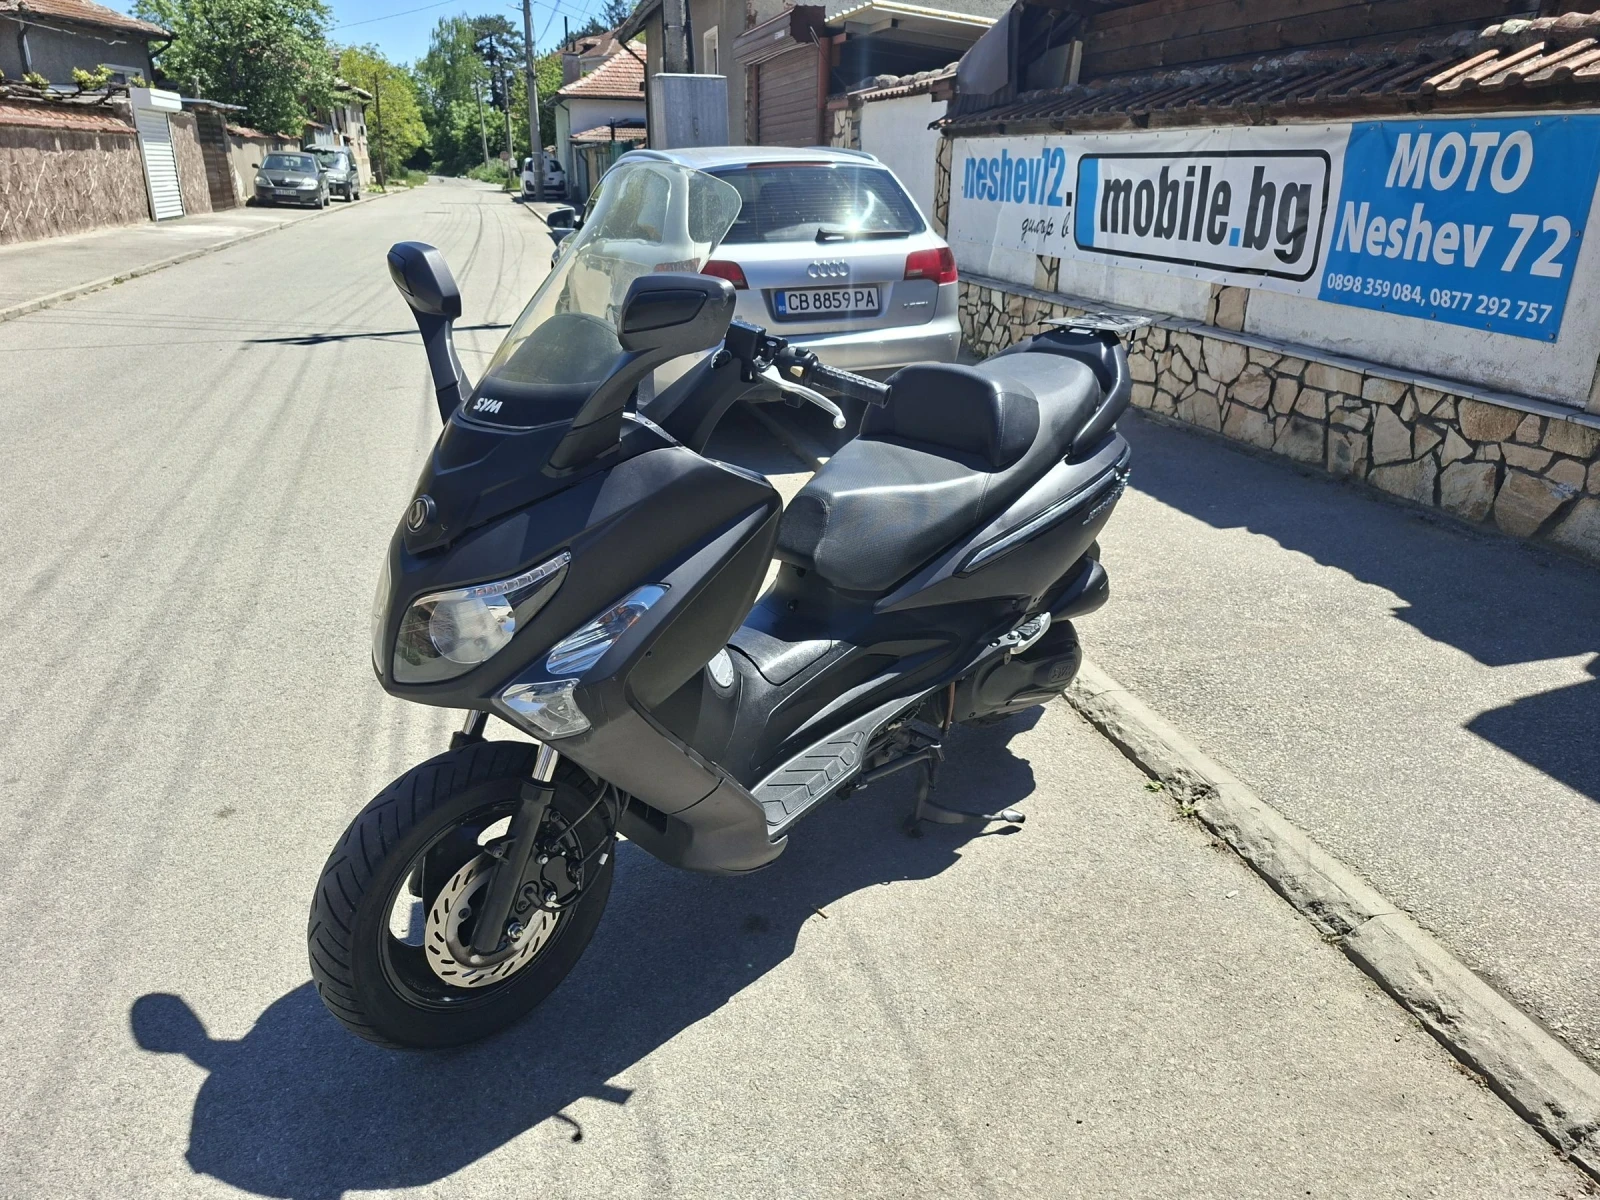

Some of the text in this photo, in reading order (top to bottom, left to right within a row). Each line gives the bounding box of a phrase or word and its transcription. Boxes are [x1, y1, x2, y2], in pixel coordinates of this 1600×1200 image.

[1385, 130, 1534, 194] MOTO
[1100, 165, 1313, 265] mobile.bg
[1336, 201, 1572, 278] Neshev 72
[813, 291, 851, 310] 8859
[1327, 272, 1553, 325] 0898 359 084, 0877 292 757
[473, 397, 503, 414] SYM
